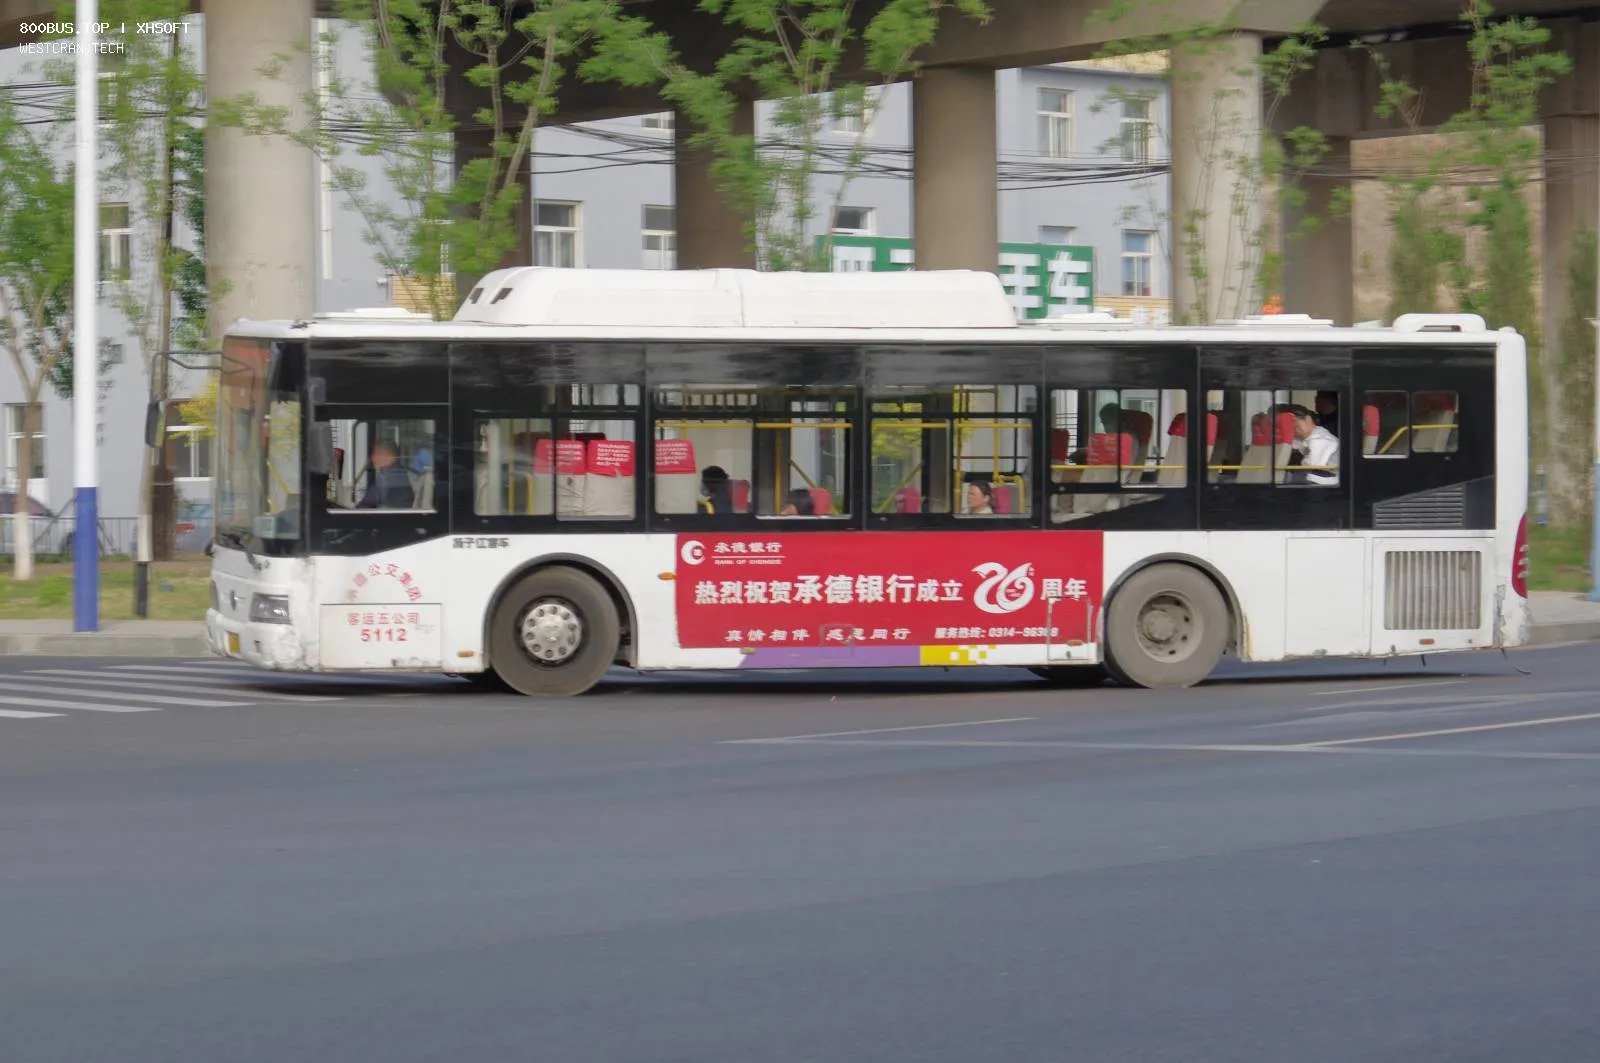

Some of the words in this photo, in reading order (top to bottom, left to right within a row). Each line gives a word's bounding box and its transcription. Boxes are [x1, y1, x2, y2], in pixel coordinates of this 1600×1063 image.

[347, 611, 420, 625] 客运五公司
[360, 627, 409, 642] 5112
